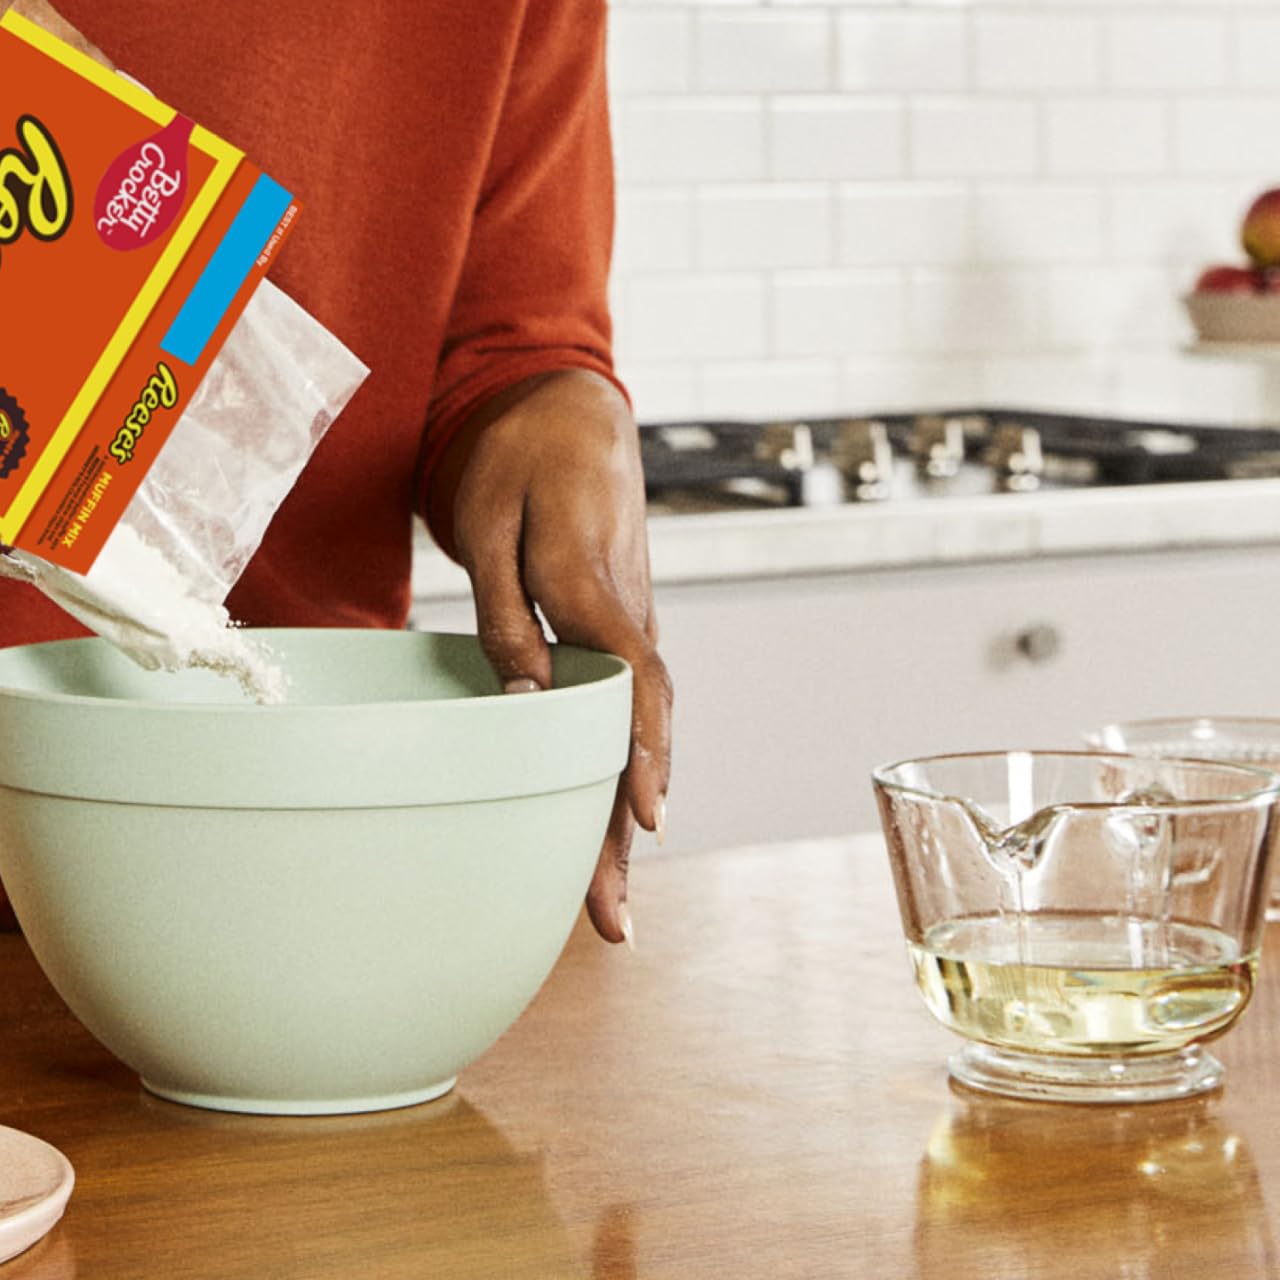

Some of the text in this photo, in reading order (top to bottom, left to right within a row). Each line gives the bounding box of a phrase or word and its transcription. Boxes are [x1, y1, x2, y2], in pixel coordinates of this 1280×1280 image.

[97, 142, 165, 234] Crocker
[119, 157, 180, 237] Betty
[278, 203, 297, 228] BEST
[110, 363, 176, 462] Reese's
[77, 471, 112, 523] MUFFIN
[61, 522, 82, 547] MIX
